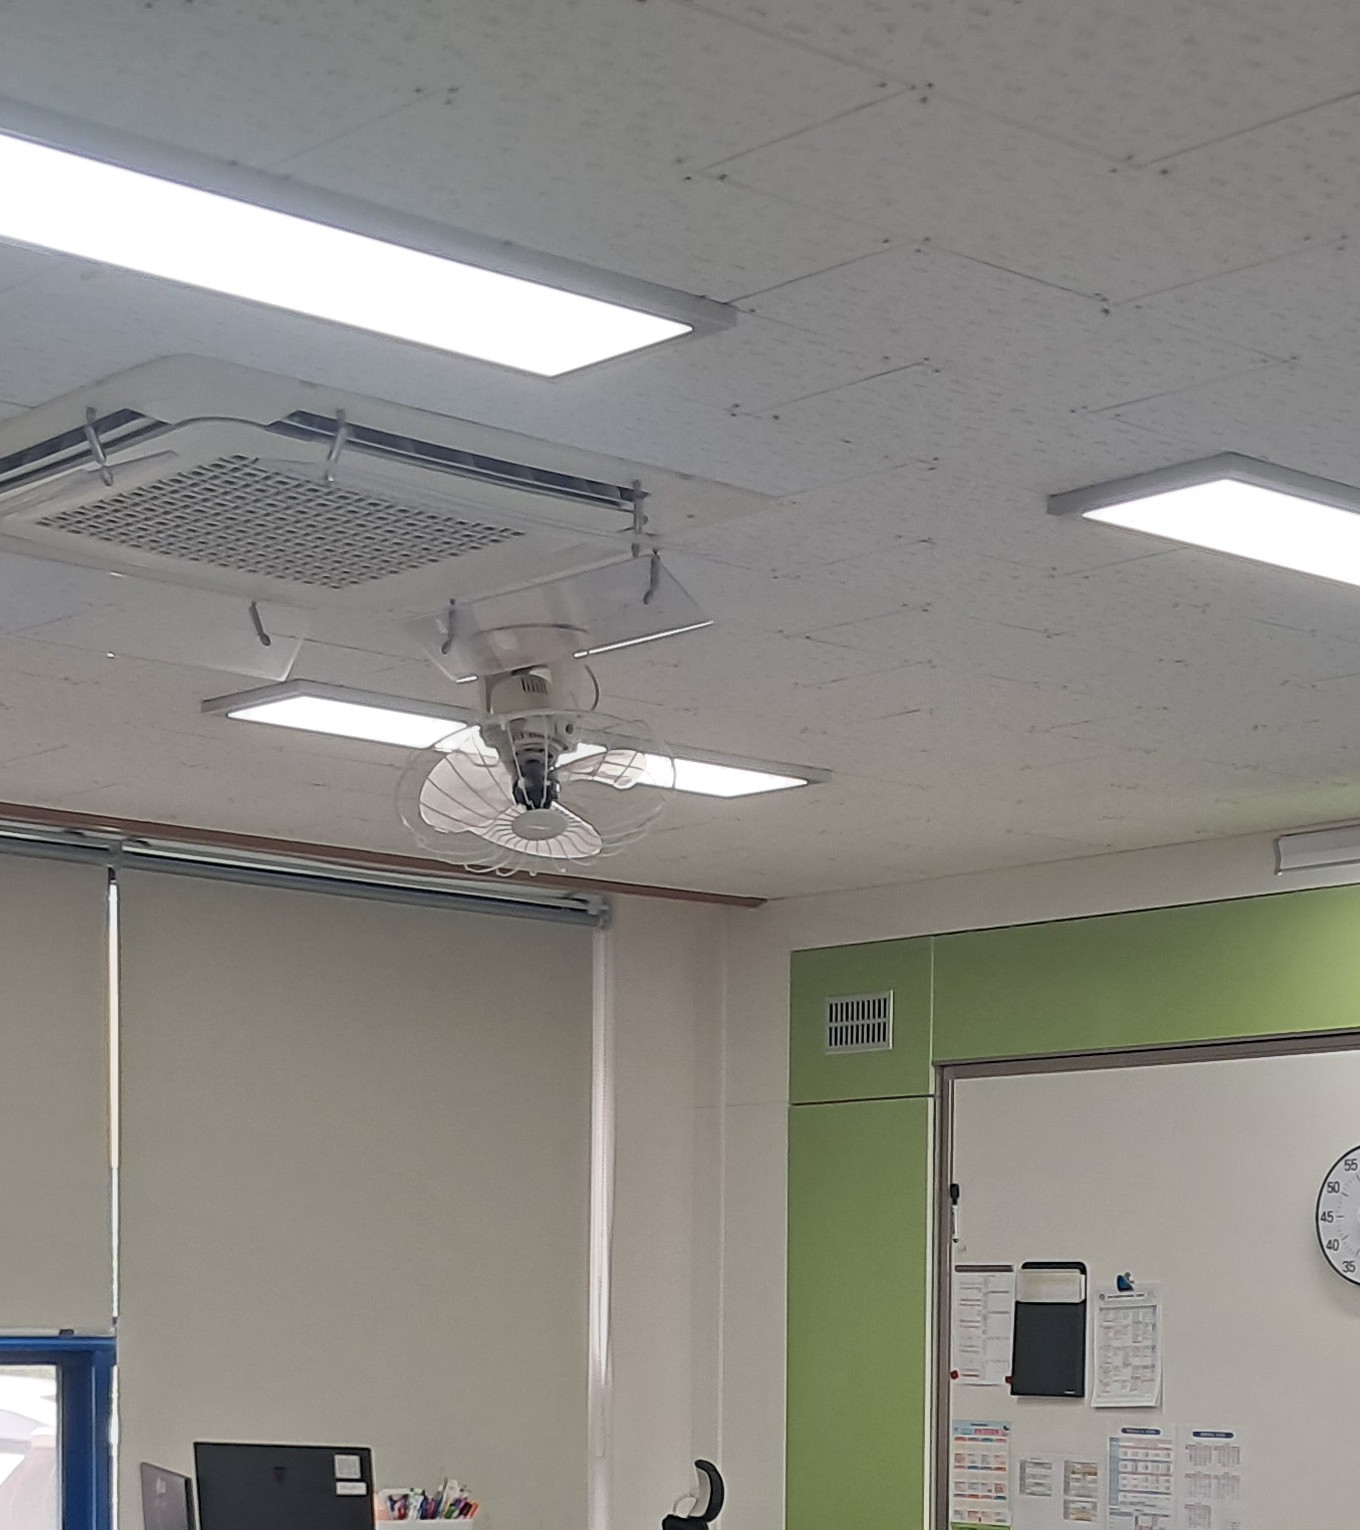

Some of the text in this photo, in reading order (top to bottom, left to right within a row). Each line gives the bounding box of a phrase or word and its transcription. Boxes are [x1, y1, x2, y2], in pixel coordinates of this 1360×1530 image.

[1344, 1158, 1358, 1172] 55
[1327, 1181, 1341, 1194] 50
[1320, 1210, 1334, 1223] 45
[1326, 1239, 1340, 1251] 40
[1342, 1260, 1357, 1273] 35
